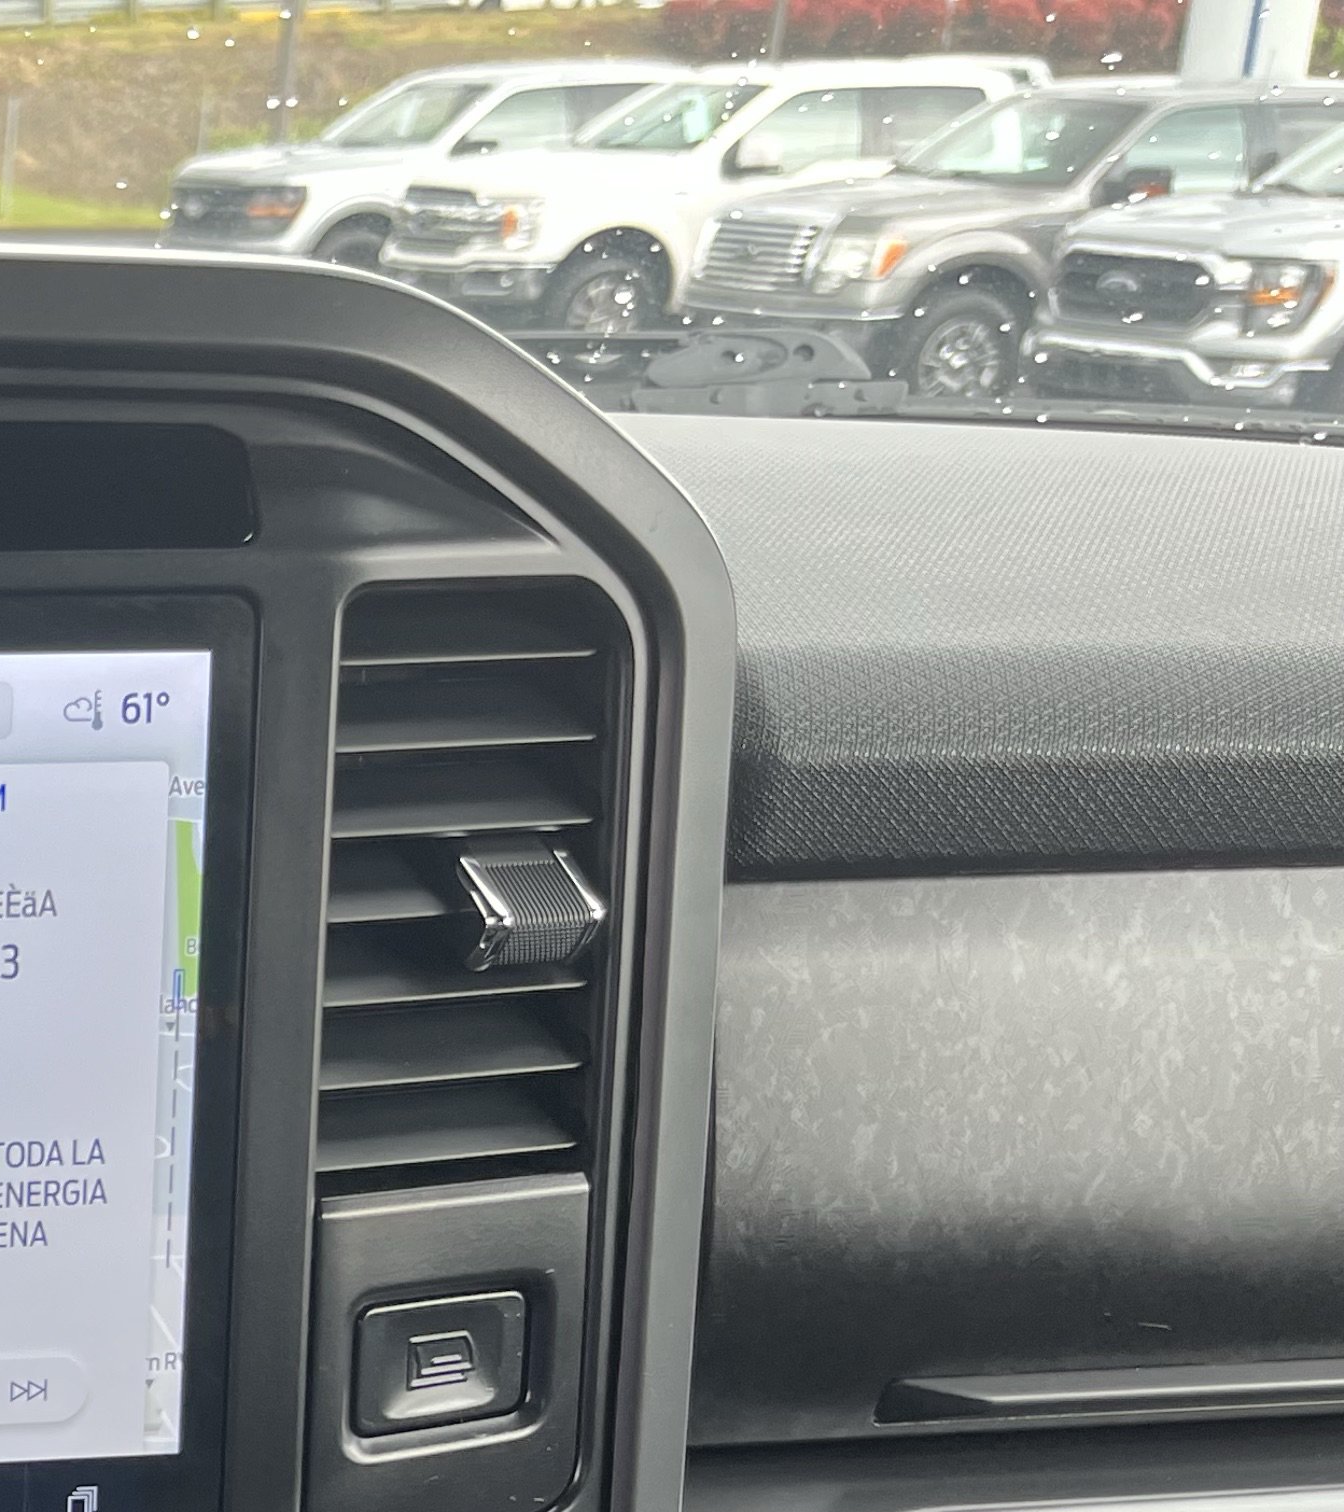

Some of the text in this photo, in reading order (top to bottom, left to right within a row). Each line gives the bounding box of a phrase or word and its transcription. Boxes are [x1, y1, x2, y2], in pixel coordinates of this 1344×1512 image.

[120, 691, 171, 725] 61°
[169, 776, 204, 796] Ave
[72, 1137, 106, 1167] LA
